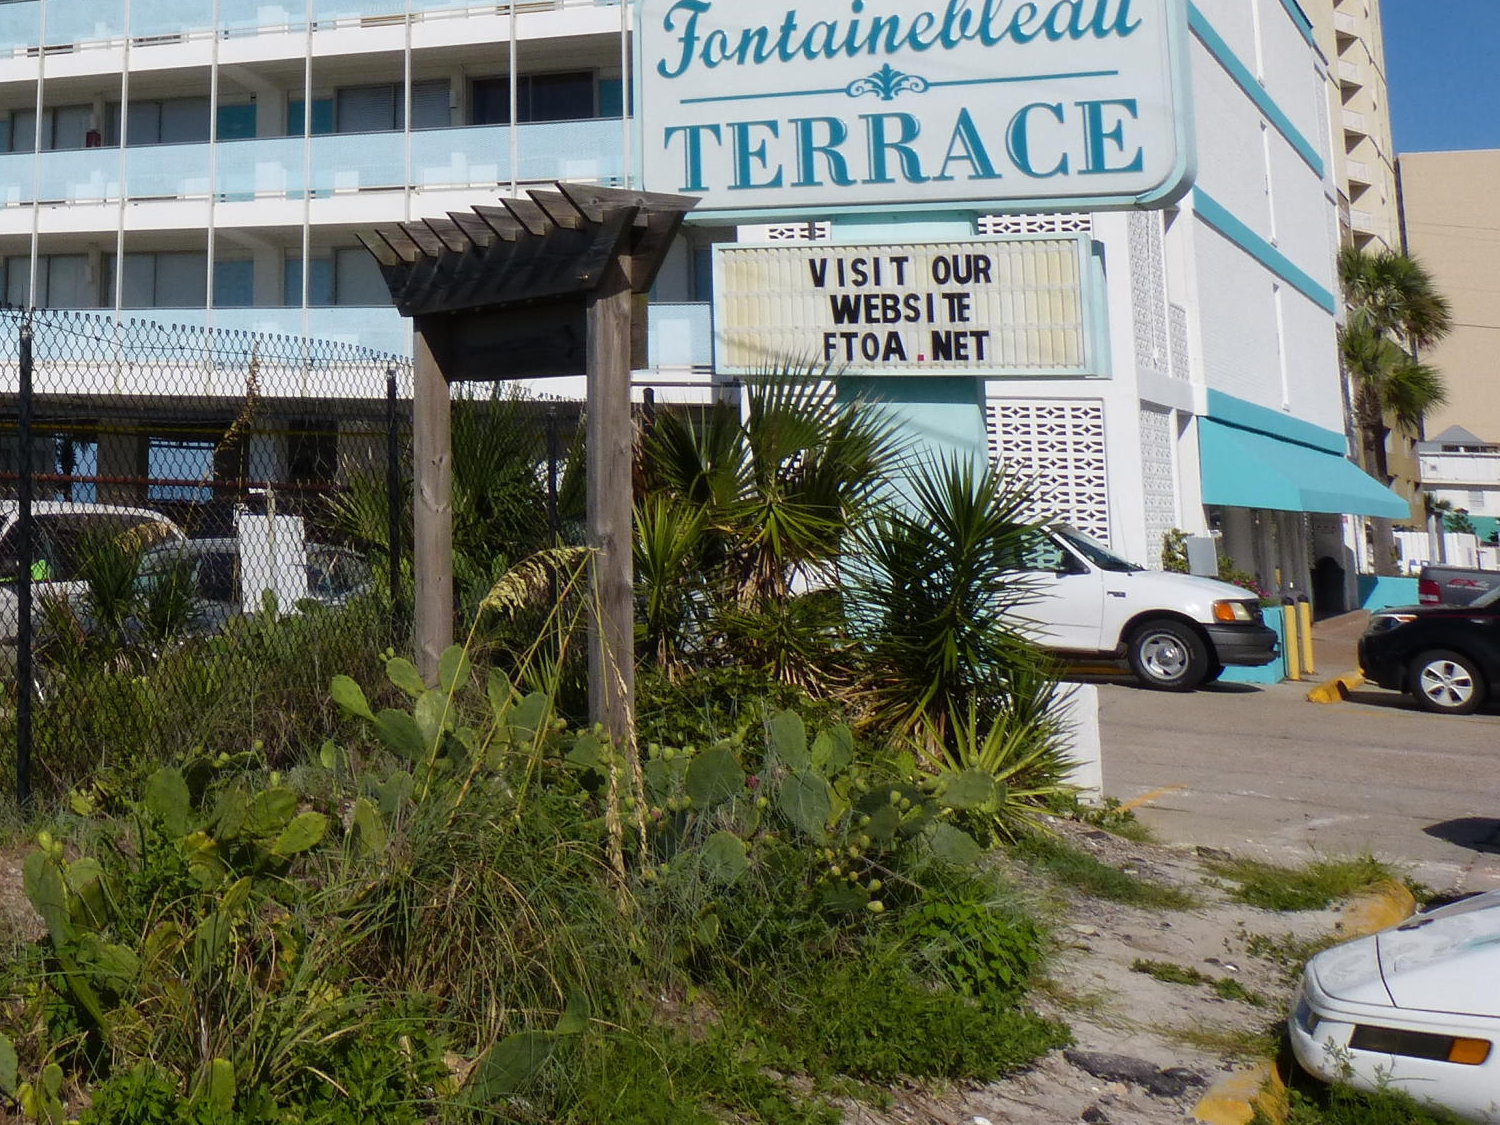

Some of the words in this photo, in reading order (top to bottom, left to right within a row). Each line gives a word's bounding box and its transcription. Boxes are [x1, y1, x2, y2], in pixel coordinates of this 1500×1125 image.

[663, 97, 1145, 194] TERRACE
[808, 256, 910, 288] VISIT
[931, 253, 993, 286] OUR
[829, 292, 971, 325] WEBSITE
[822, 329, 991, 363] FTOA.NET
